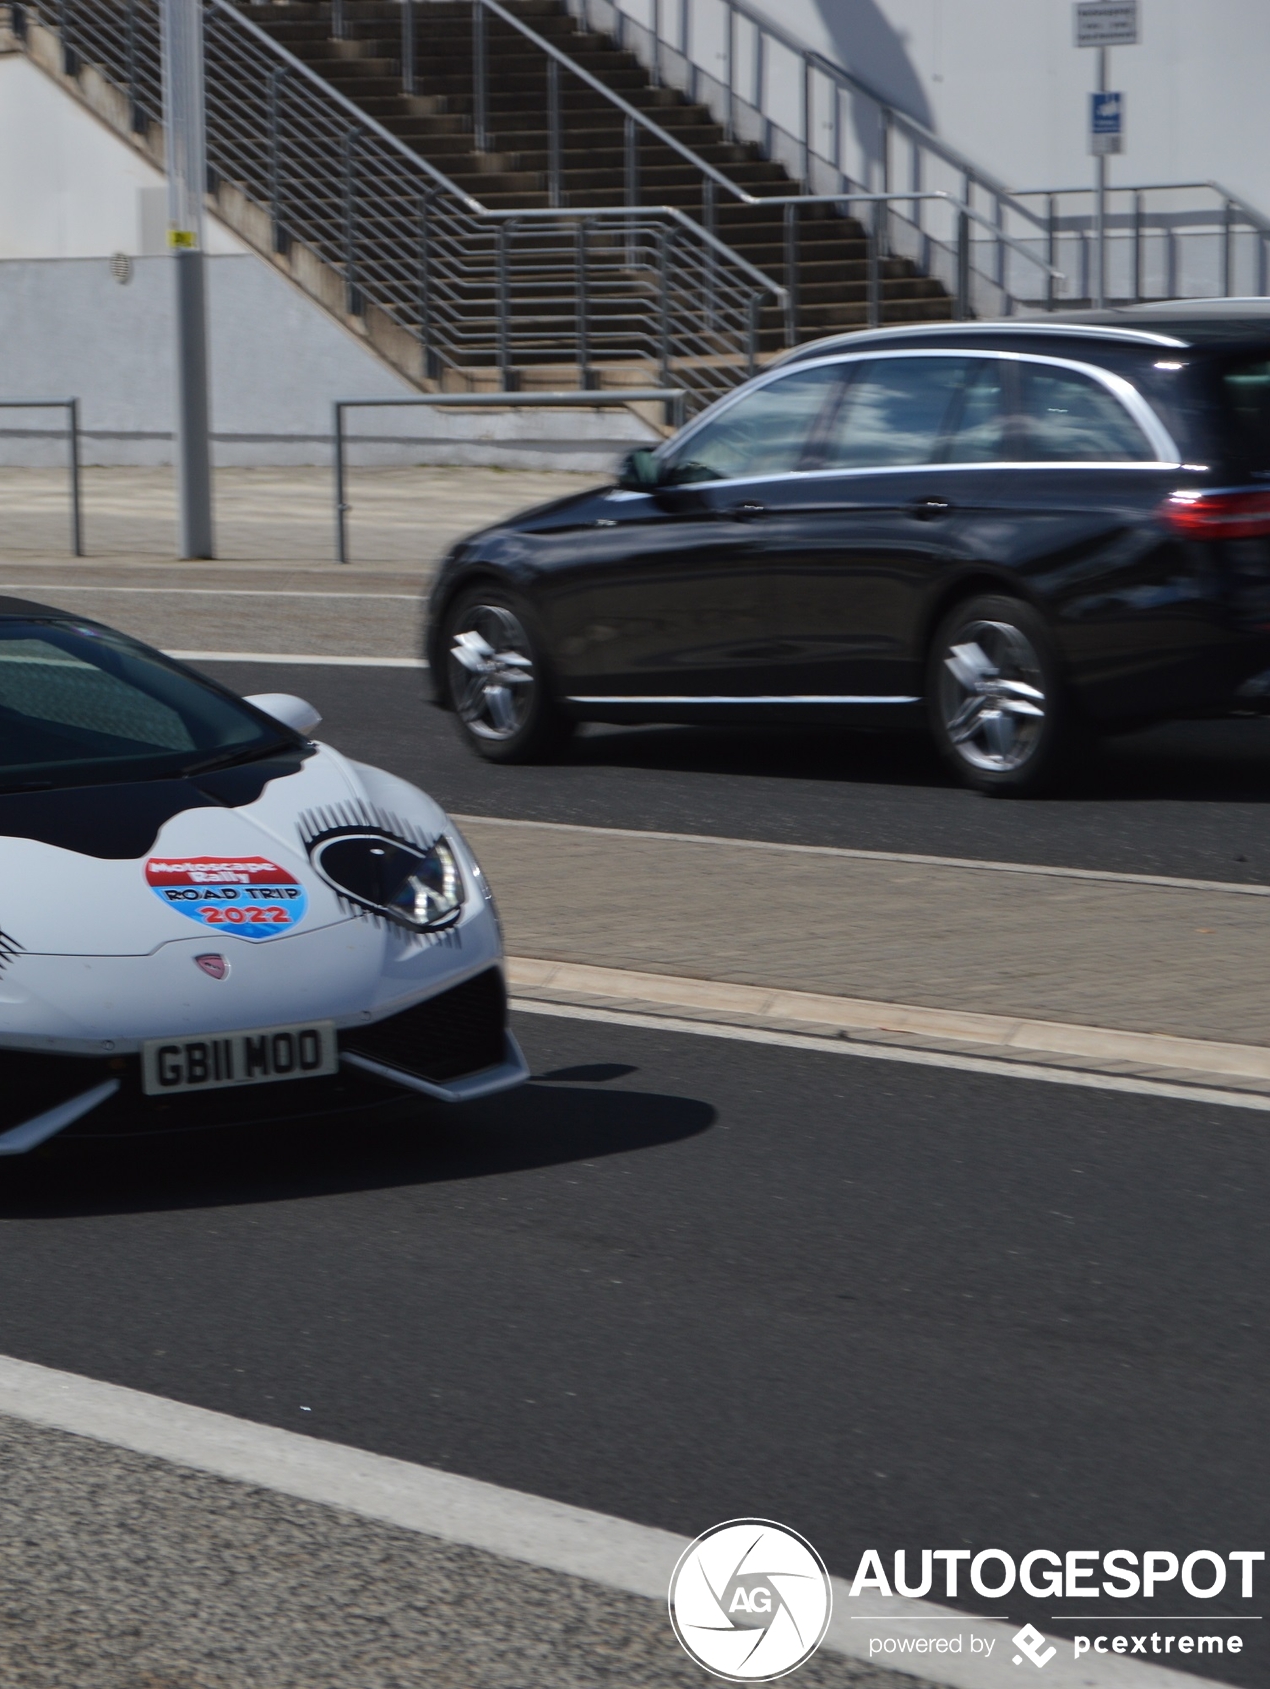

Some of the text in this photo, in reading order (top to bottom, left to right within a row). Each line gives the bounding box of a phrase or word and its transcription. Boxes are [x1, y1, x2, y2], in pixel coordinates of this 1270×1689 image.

[188, 871, 250, 883] Rally
[165, 887, 301, 901] ROAD TRIP
[200, 906, 293, 924] 2022
[157, 1029, 322, 1087] GB11 MOO
